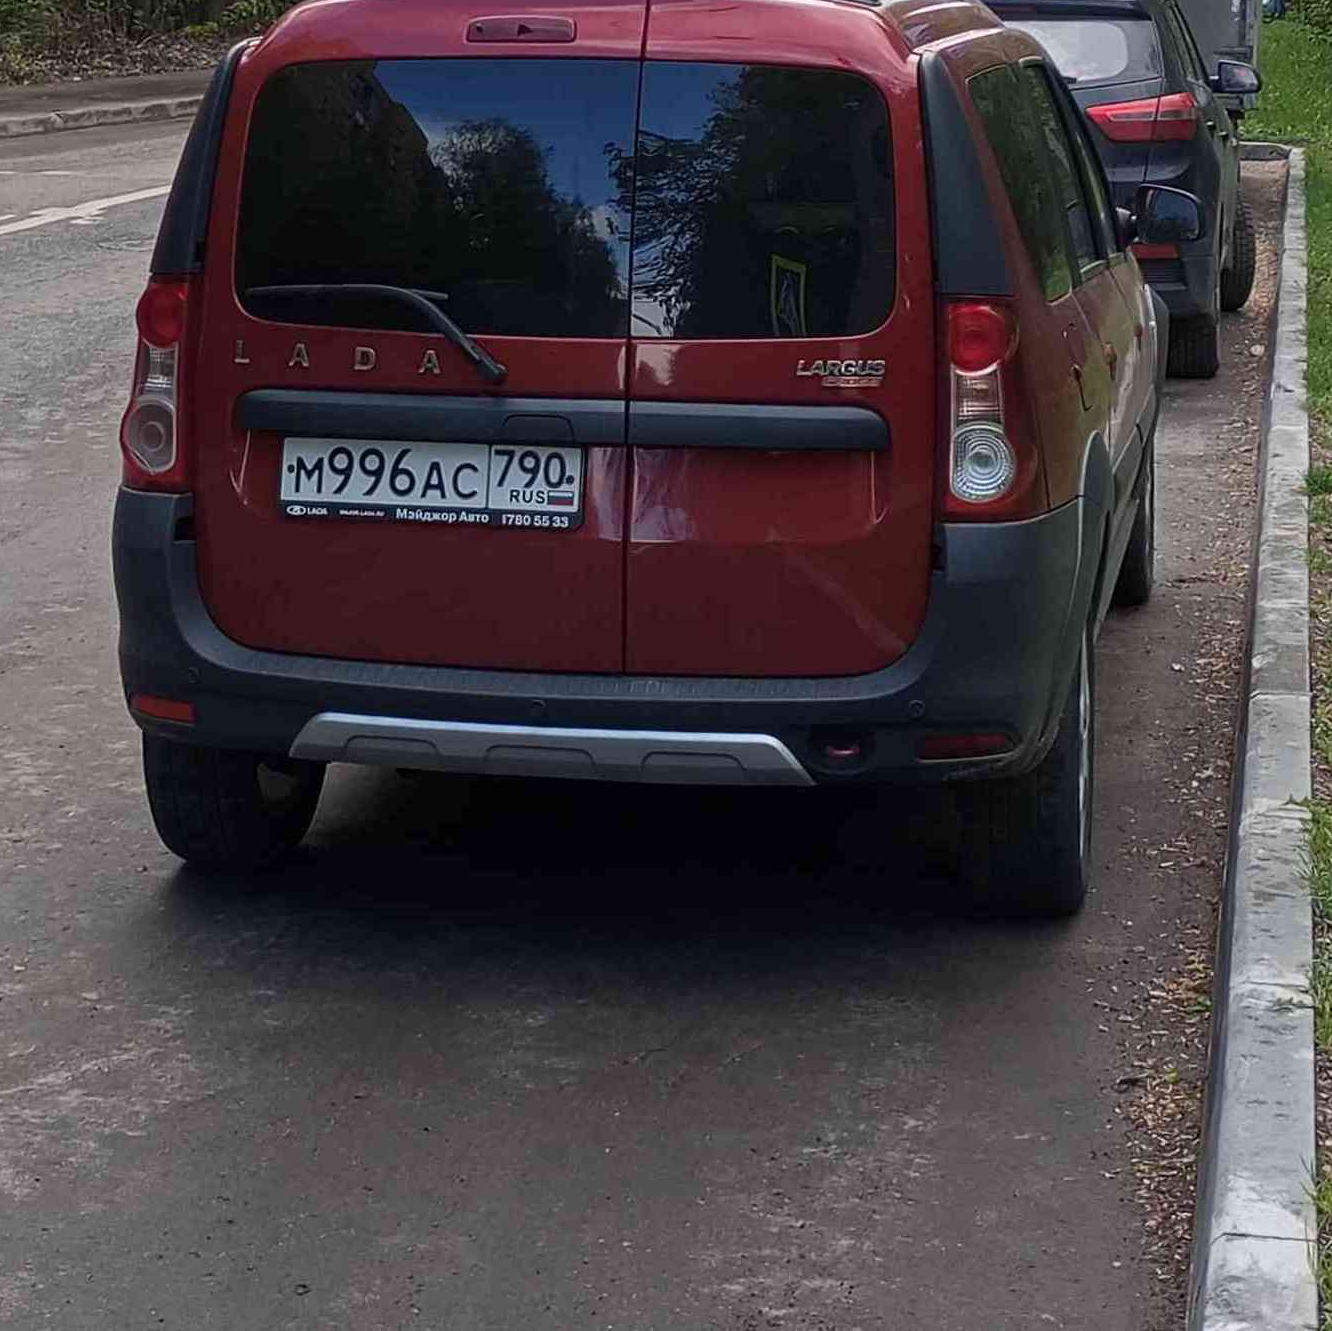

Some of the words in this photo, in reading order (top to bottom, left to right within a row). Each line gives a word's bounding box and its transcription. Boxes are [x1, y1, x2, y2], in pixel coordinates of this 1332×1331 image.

[234, 339, 441, 374] LADA
[796, 359, 886, 376] LARGUS
[494, 449, 566, 489] 790
[509, 490, 546, 504] RUS
[396, 508, 457, 523] Мэйджор
[459, 512, 489, 524] Авто
[533, 515, 550, 527] 55
[551, 515, 569, 528] 33
